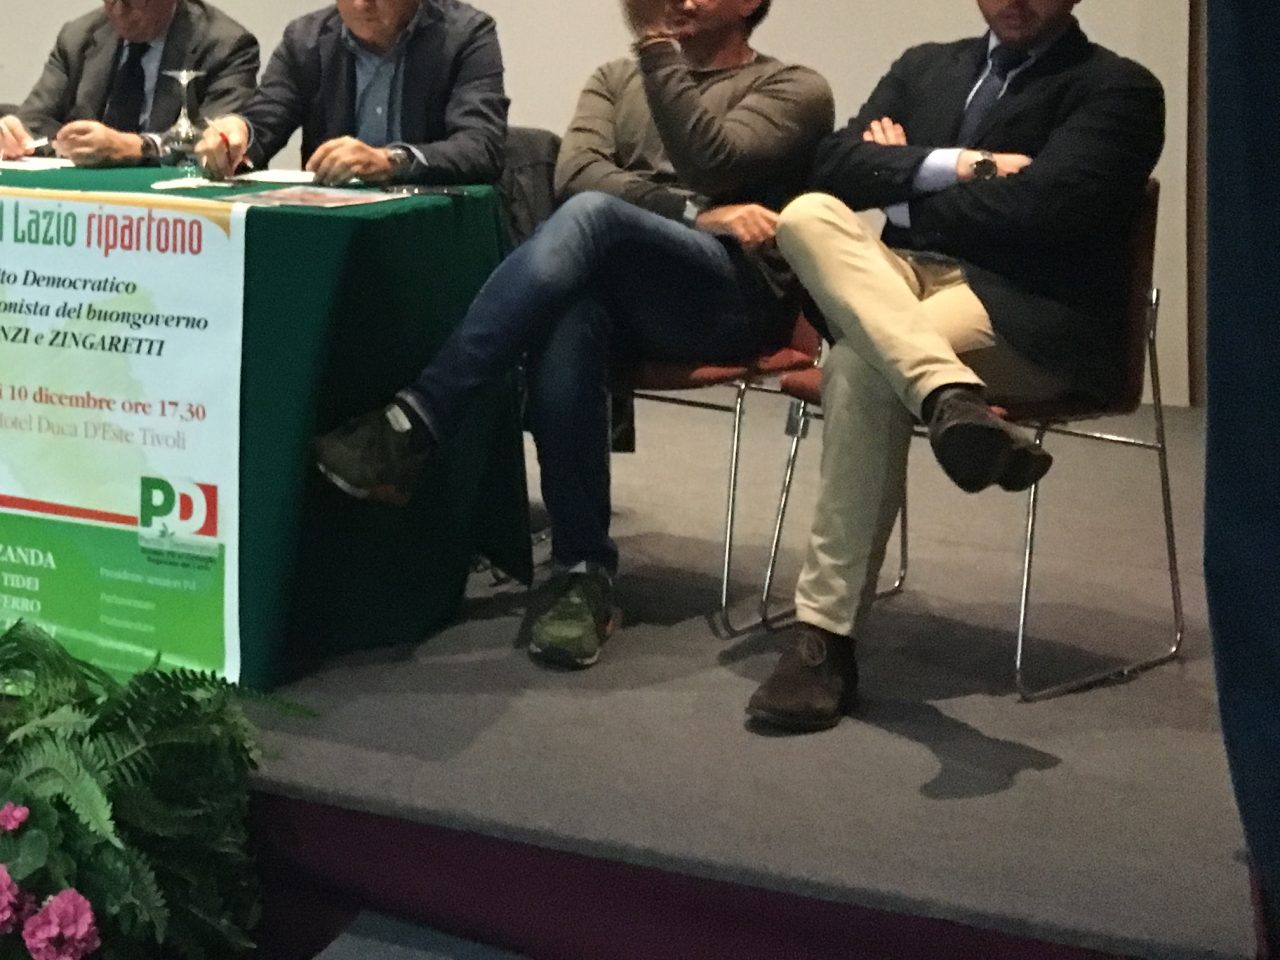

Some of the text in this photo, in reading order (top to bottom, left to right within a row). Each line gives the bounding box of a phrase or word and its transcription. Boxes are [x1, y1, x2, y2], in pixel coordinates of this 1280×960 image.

[13, 206, 77, 247] Lazio
[86, 208, 203, 257] ripartono
[22, 270, 137, 295] Democratico
[55, 302, 83, 320] del
[86, 304, 209, 332] buongoverno
[34, 333, 45, 346] e
[48, 332, 165, 358] ZINGARETTI
[10, 384, 28, 401] 10
[33, 386, 116, 412] dicembre
[121, 401, 152, 416] ore
[159, 400, 207, 423] 17,30
[37, 417, 77, 438] Duca
[84, 420, 134, 444] D'Este
[139, 427, 186, 451] Tivoli
[140, 476, 218, 537] PD
[1, 572, 40, 591] TIDEI
